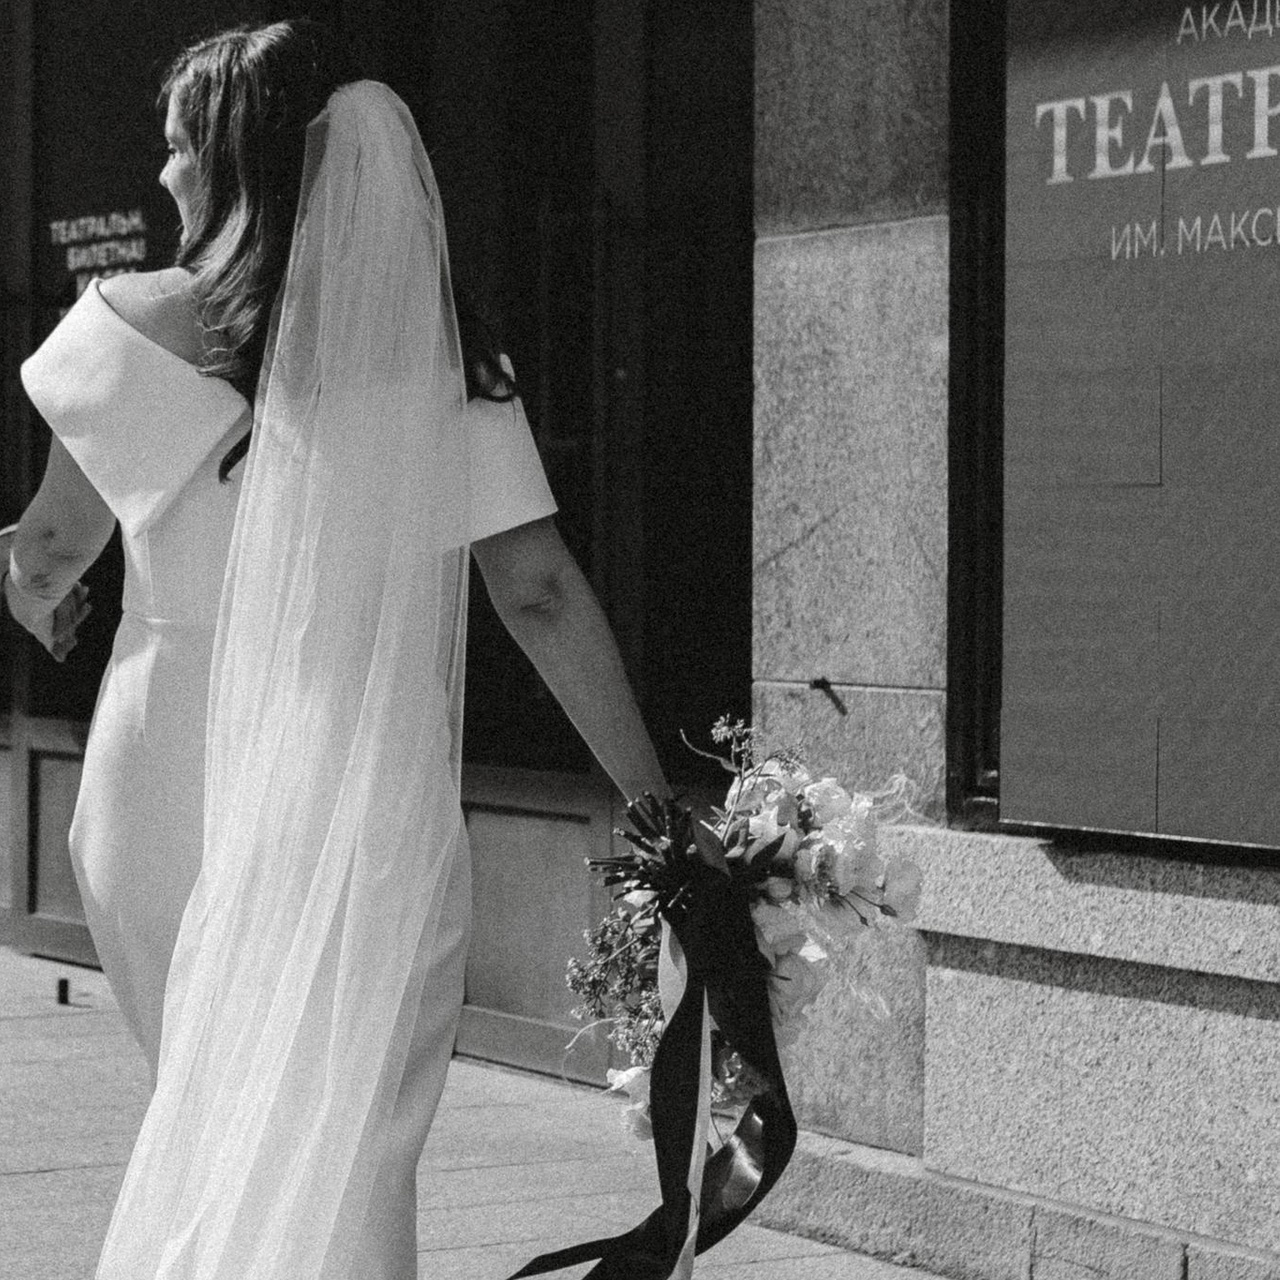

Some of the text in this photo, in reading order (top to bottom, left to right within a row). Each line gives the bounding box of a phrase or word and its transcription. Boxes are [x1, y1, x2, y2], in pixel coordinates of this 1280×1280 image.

[1034, 65, 1280, 186] ТЕАТР
[1111, 206, 1280, 261] ИМ. МАКС
